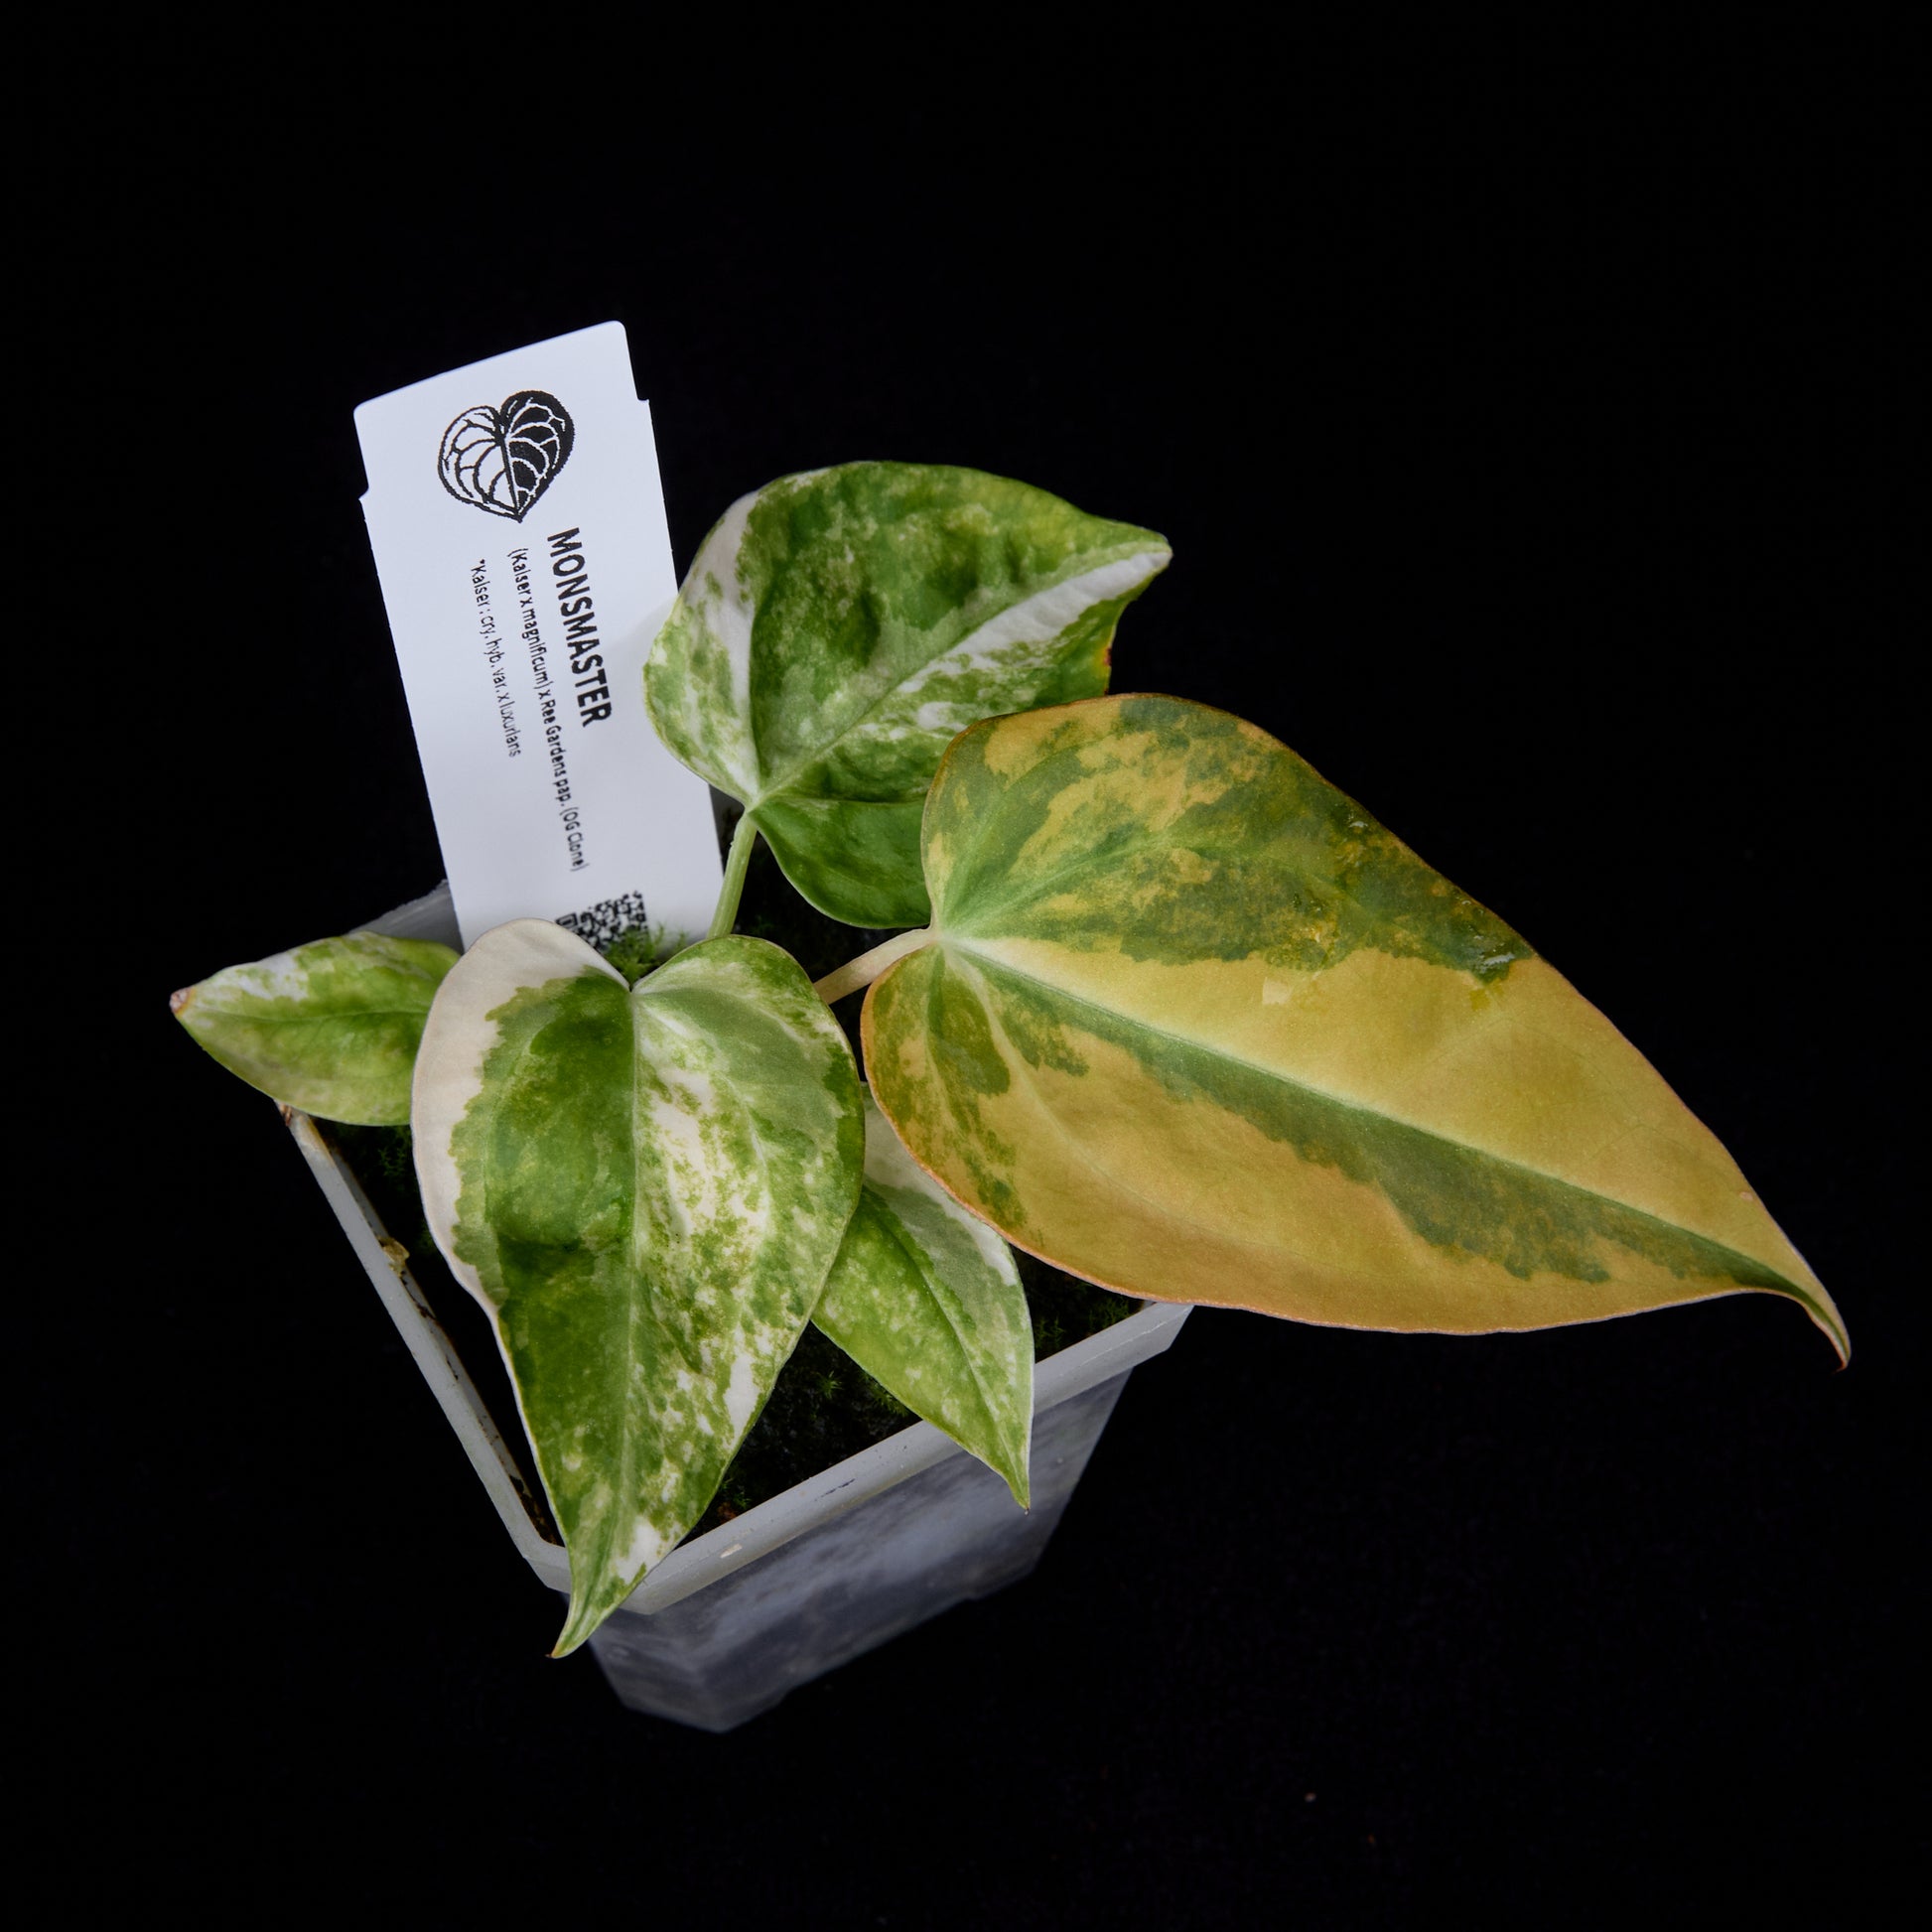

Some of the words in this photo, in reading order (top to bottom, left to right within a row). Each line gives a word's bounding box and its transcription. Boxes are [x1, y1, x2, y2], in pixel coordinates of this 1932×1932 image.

[518, 596, 534, 609] x
[479, 615, 496, 639] cry.
[546, 526, 613, 728] MONSMASTER
[483, 637, 505, 668] hyb.
[491, 667, 508, 693] var.
[496, 692, 510, 704] x
[537, 688, 552, 701] x
[545, 725, 567, 778] Gardens
[552, 777, 572, 807] pap.
[559, 806, 581, 832] (OG
